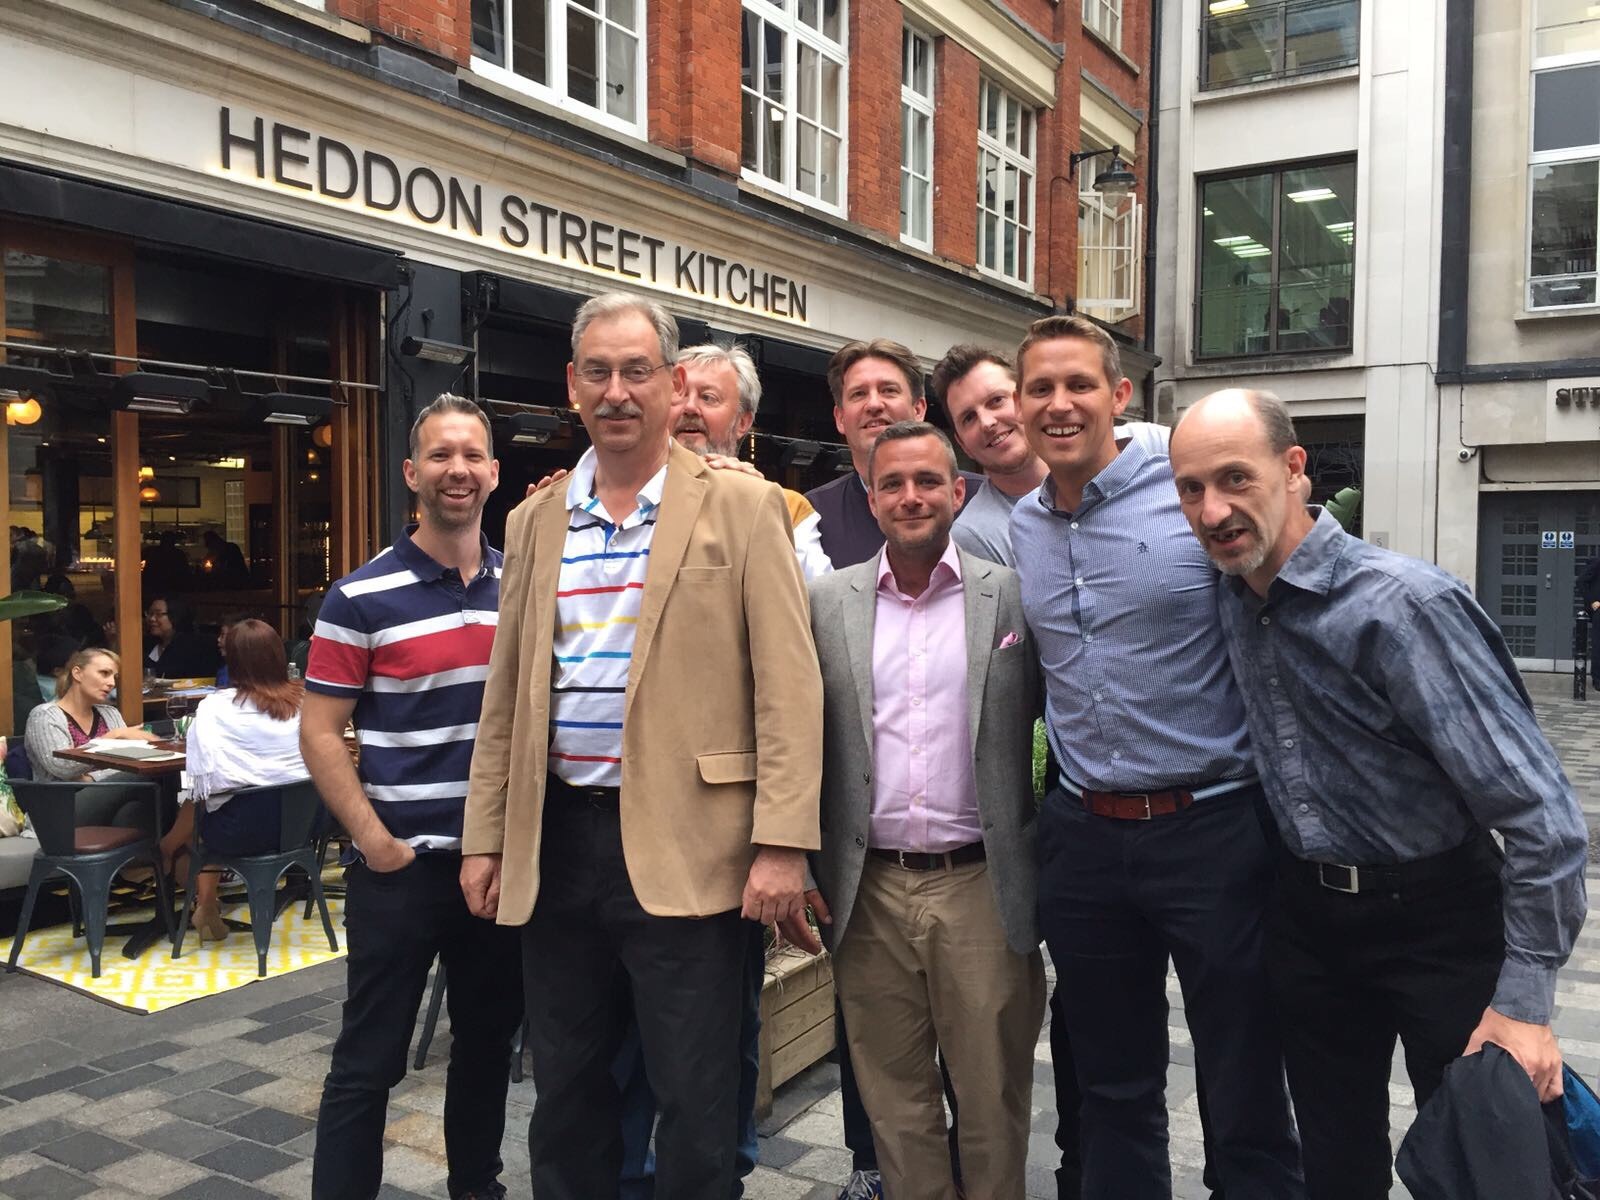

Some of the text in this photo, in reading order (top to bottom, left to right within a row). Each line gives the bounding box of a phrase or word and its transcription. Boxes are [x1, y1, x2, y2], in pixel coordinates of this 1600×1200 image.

[221, 106, 807, 322] HEDDON STREET KITCHEN
